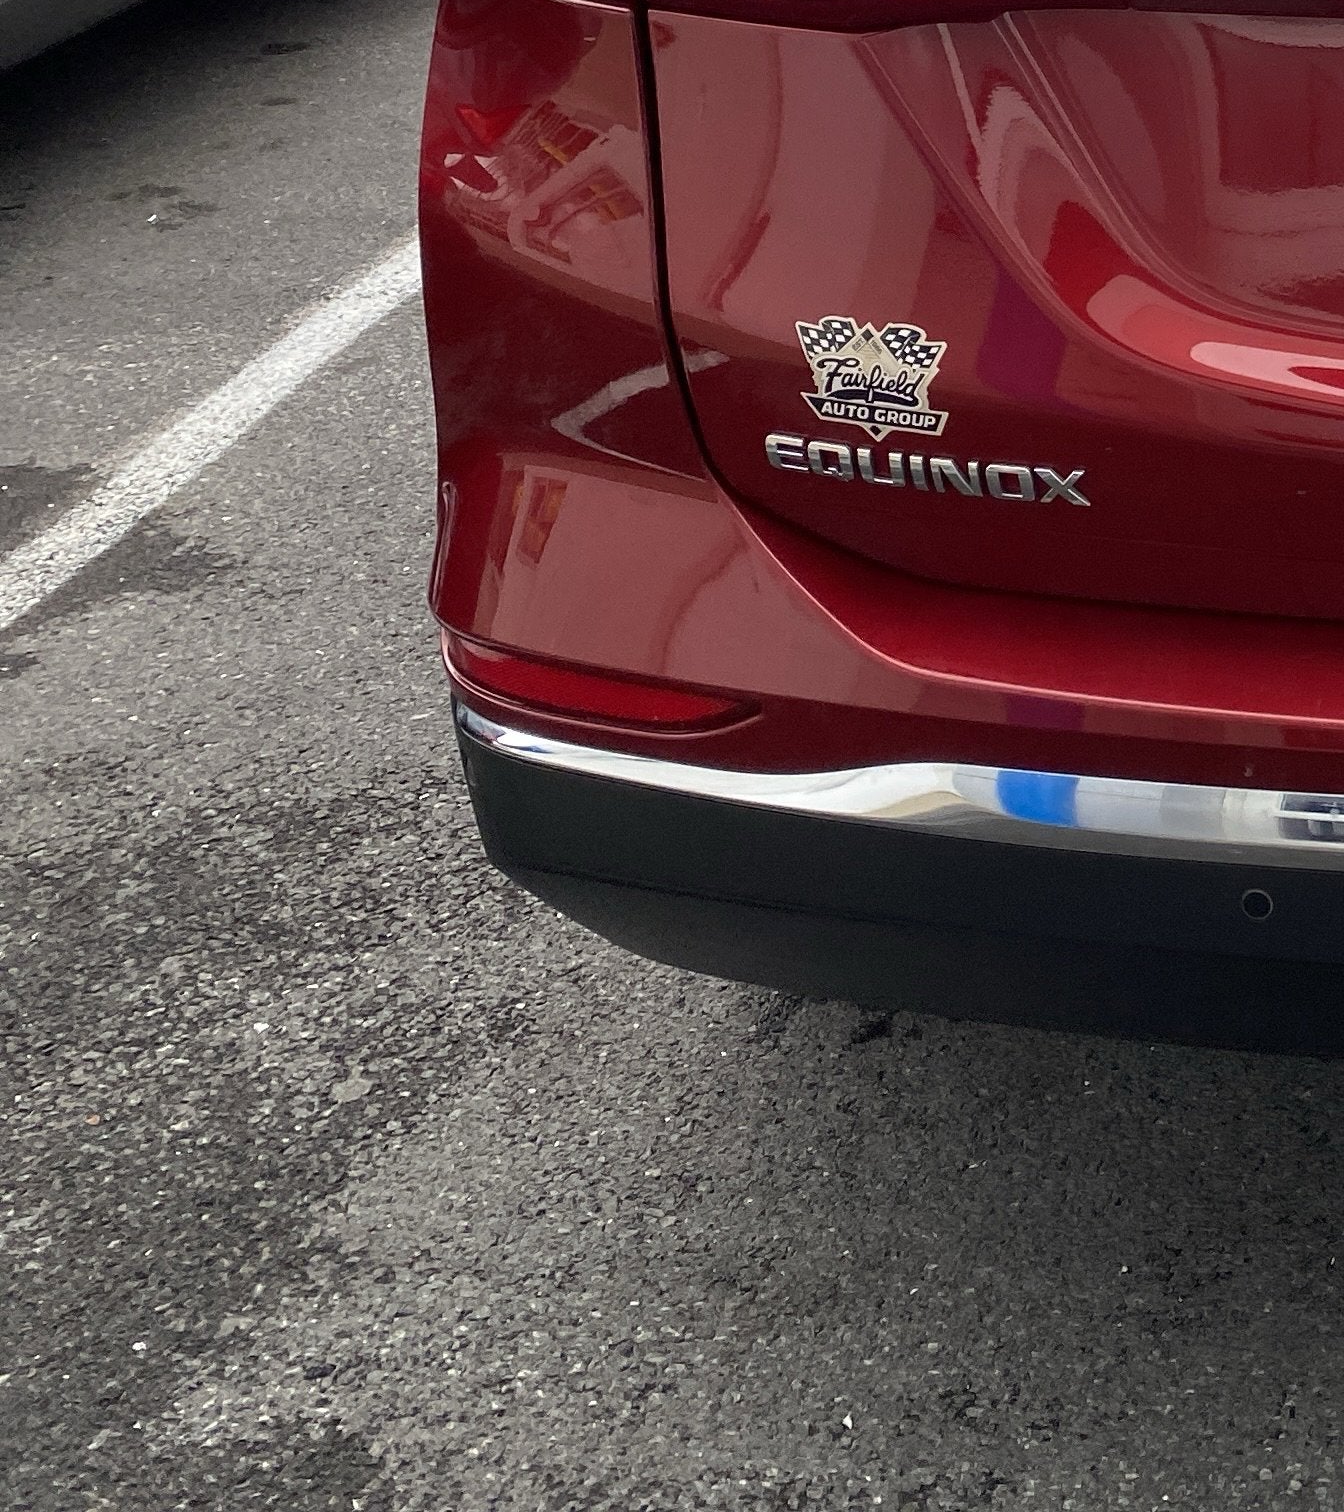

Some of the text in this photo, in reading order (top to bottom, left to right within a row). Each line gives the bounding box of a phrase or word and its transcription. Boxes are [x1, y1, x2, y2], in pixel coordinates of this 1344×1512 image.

[816, 357, 926, 399] Fairfield
[820, 401, 937, 429] AUTO GROUP
[764, 433, 1091, 506] EQUINOX
